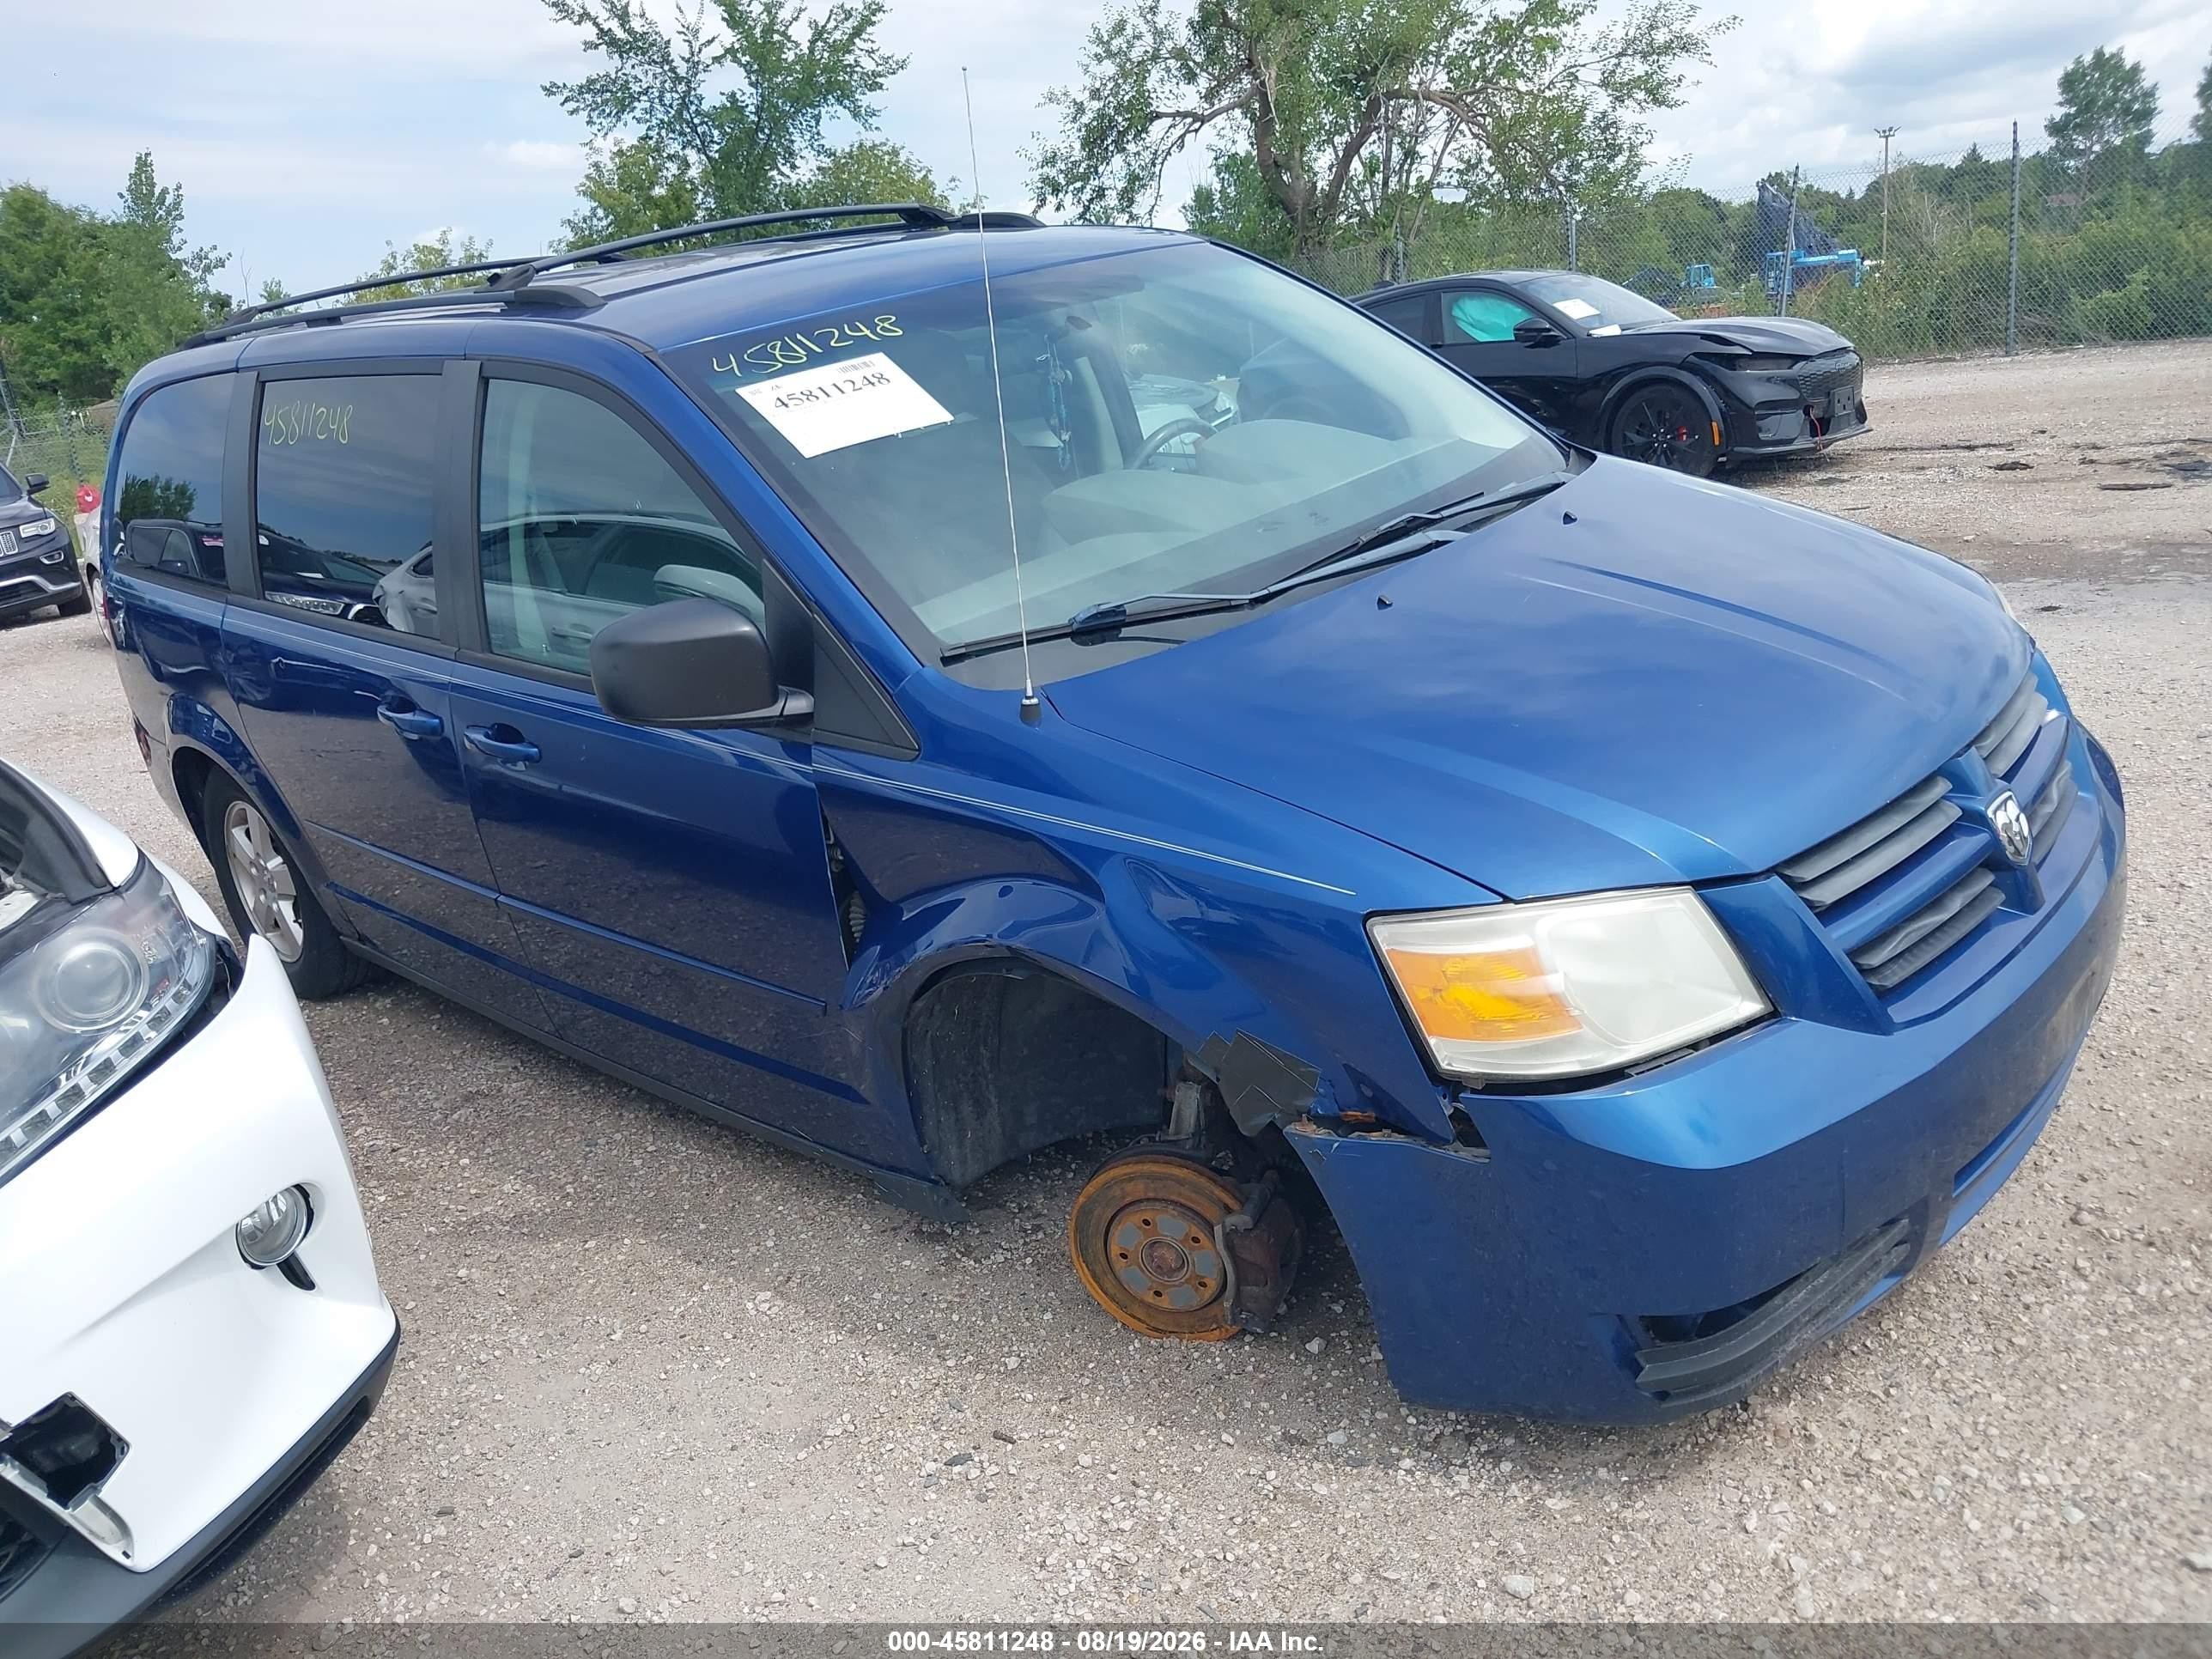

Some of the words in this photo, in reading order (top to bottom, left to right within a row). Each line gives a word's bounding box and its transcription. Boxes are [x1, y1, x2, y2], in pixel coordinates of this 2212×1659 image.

[712, 315, 903, 377] 45811248
[775, 372, 891, 409] 45811248
[264, 400, 353, 447] 45811248
